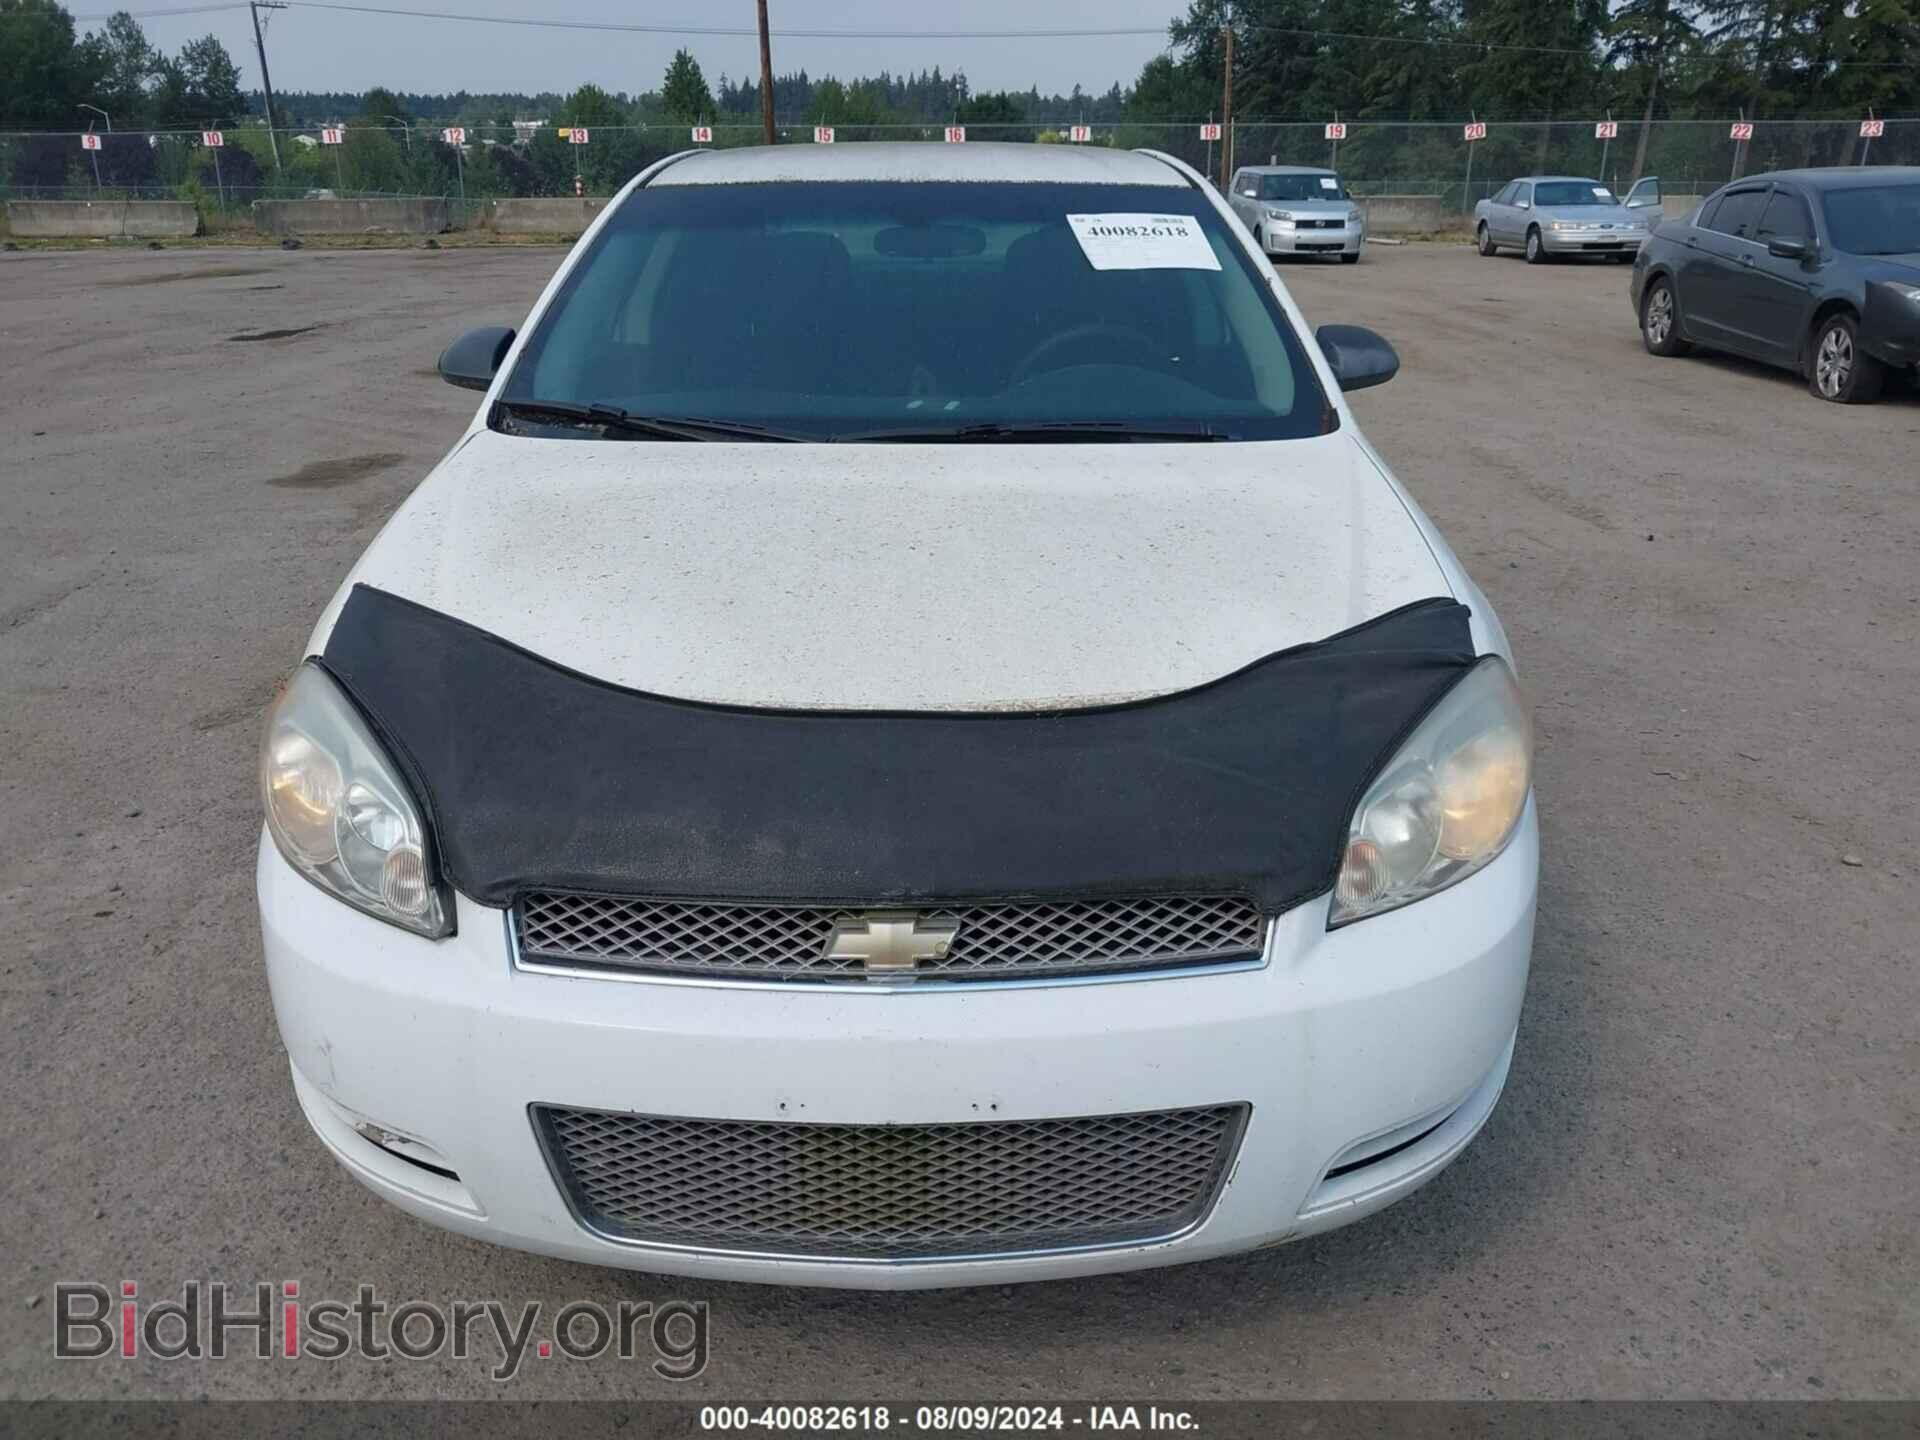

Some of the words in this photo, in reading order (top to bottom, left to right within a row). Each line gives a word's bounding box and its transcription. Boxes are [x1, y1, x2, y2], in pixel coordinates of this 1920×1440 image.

[450, 129, 461, 141] 12
[572, 129, 584, 142] 13
[696, 128, 708, 141] 14
[818, 128, 831, 141] 15
[949, 128, 961, 141] 16
[1076, 127, 1086, 139] 17
[1205, 125, 1217, 139] 18
[1330, 125, 1343, 138] 19
[1467, 124, 1484, 139] 20
[1600, 124, 1613, 137] 21
[1733, 125, 1750, 138] 22
[1863, 122, 1881, 136] 23
[87, 136, 96, 149] 9
[207, 131, 220, 145] 10
[327, 131, 337, 143] 11
[1087, 226, 1189, 237] 40082618
